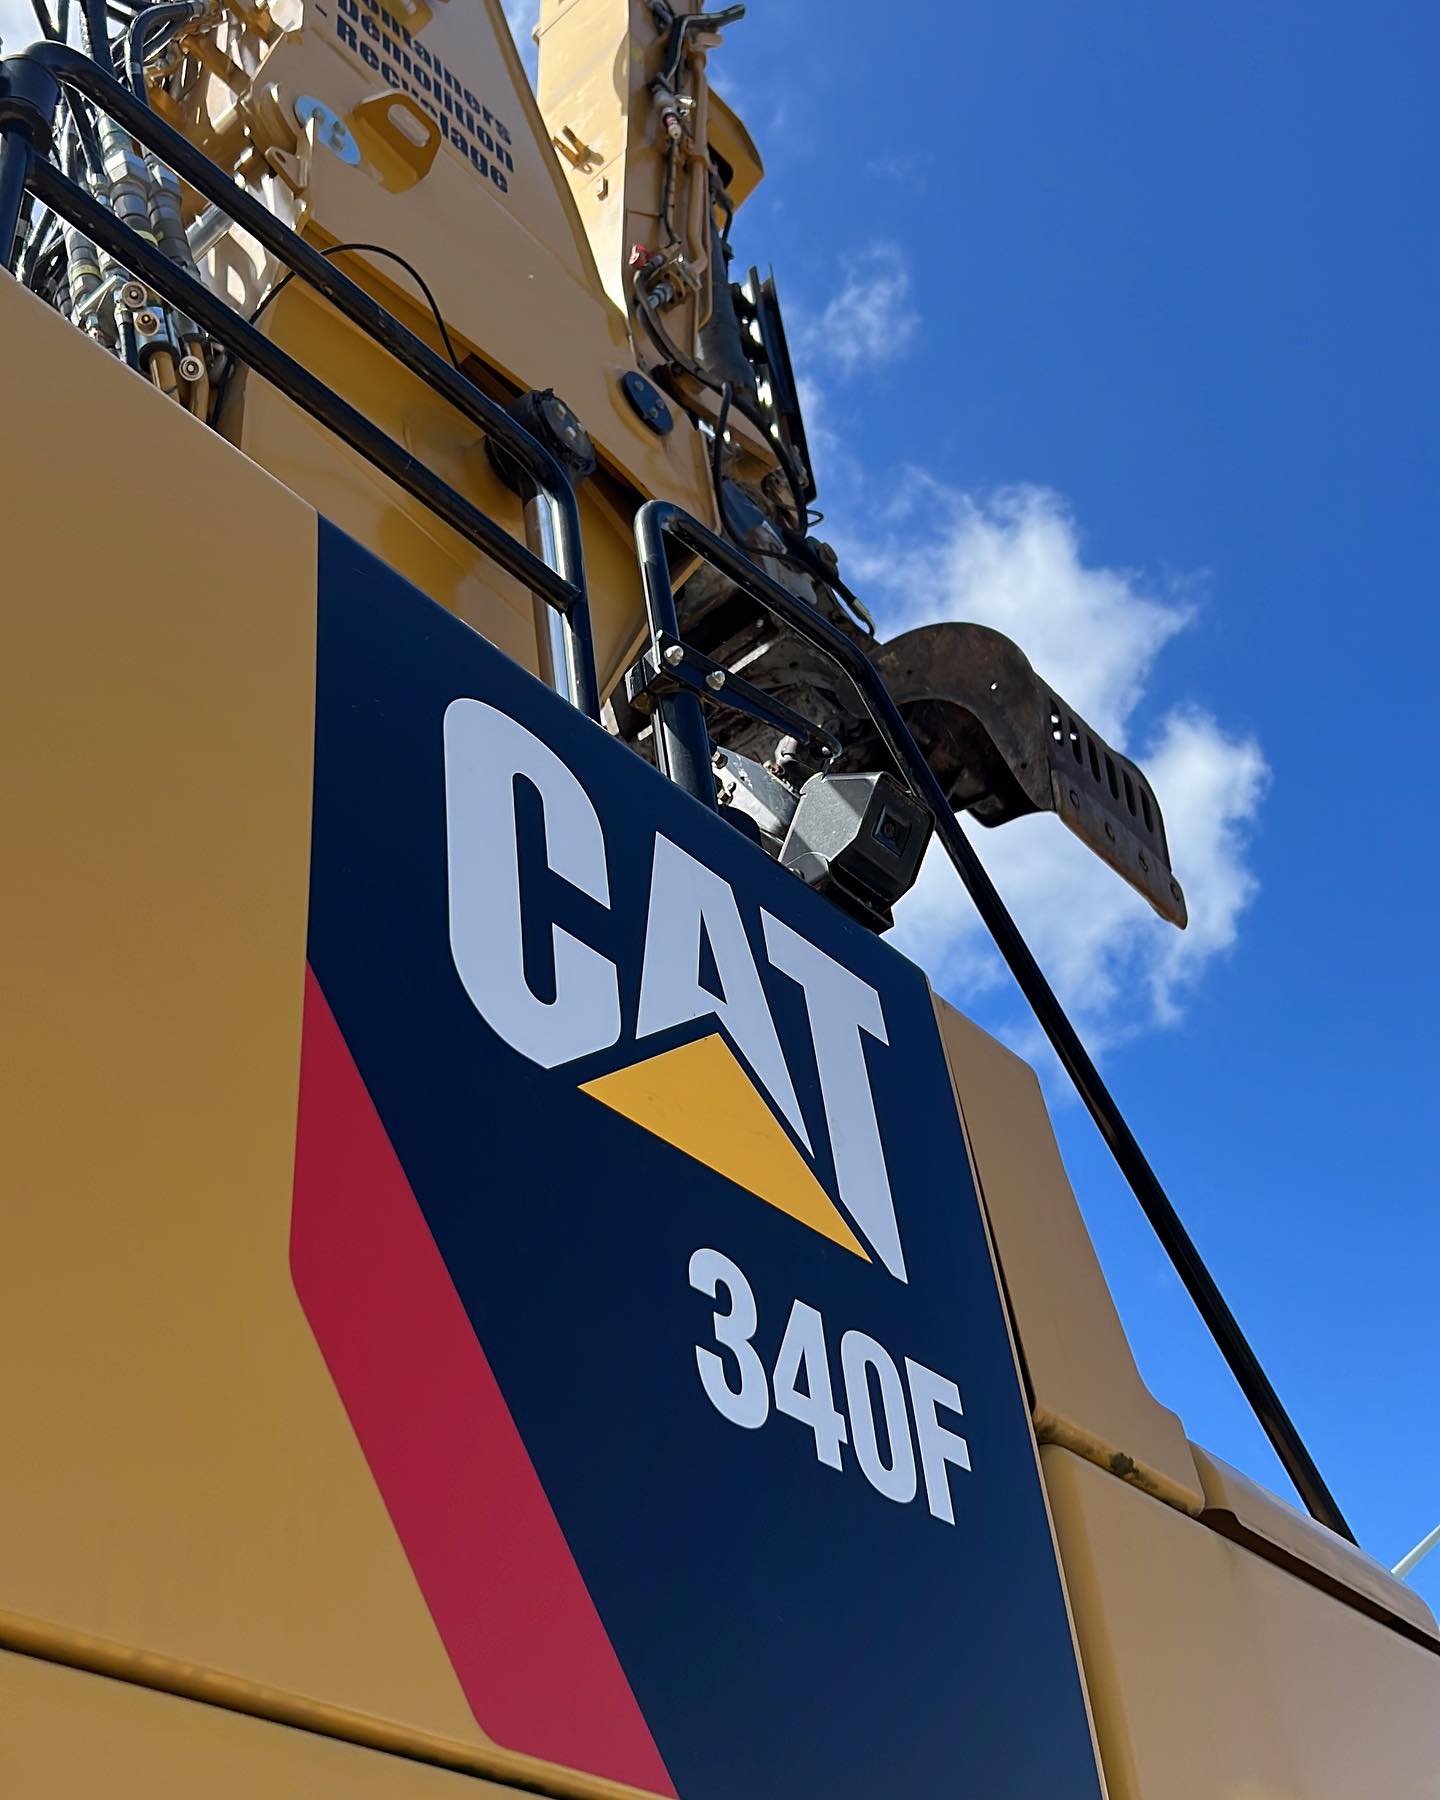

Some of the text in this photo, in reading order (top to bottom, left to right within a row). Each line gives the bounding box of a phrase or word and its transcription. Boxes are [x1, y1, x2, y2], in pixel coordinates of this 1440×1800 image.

[336, 14, 509, 193] Reclage
[443, 697, 908, 1284] CAT
[688, 1247, 972, 1527] 340F
